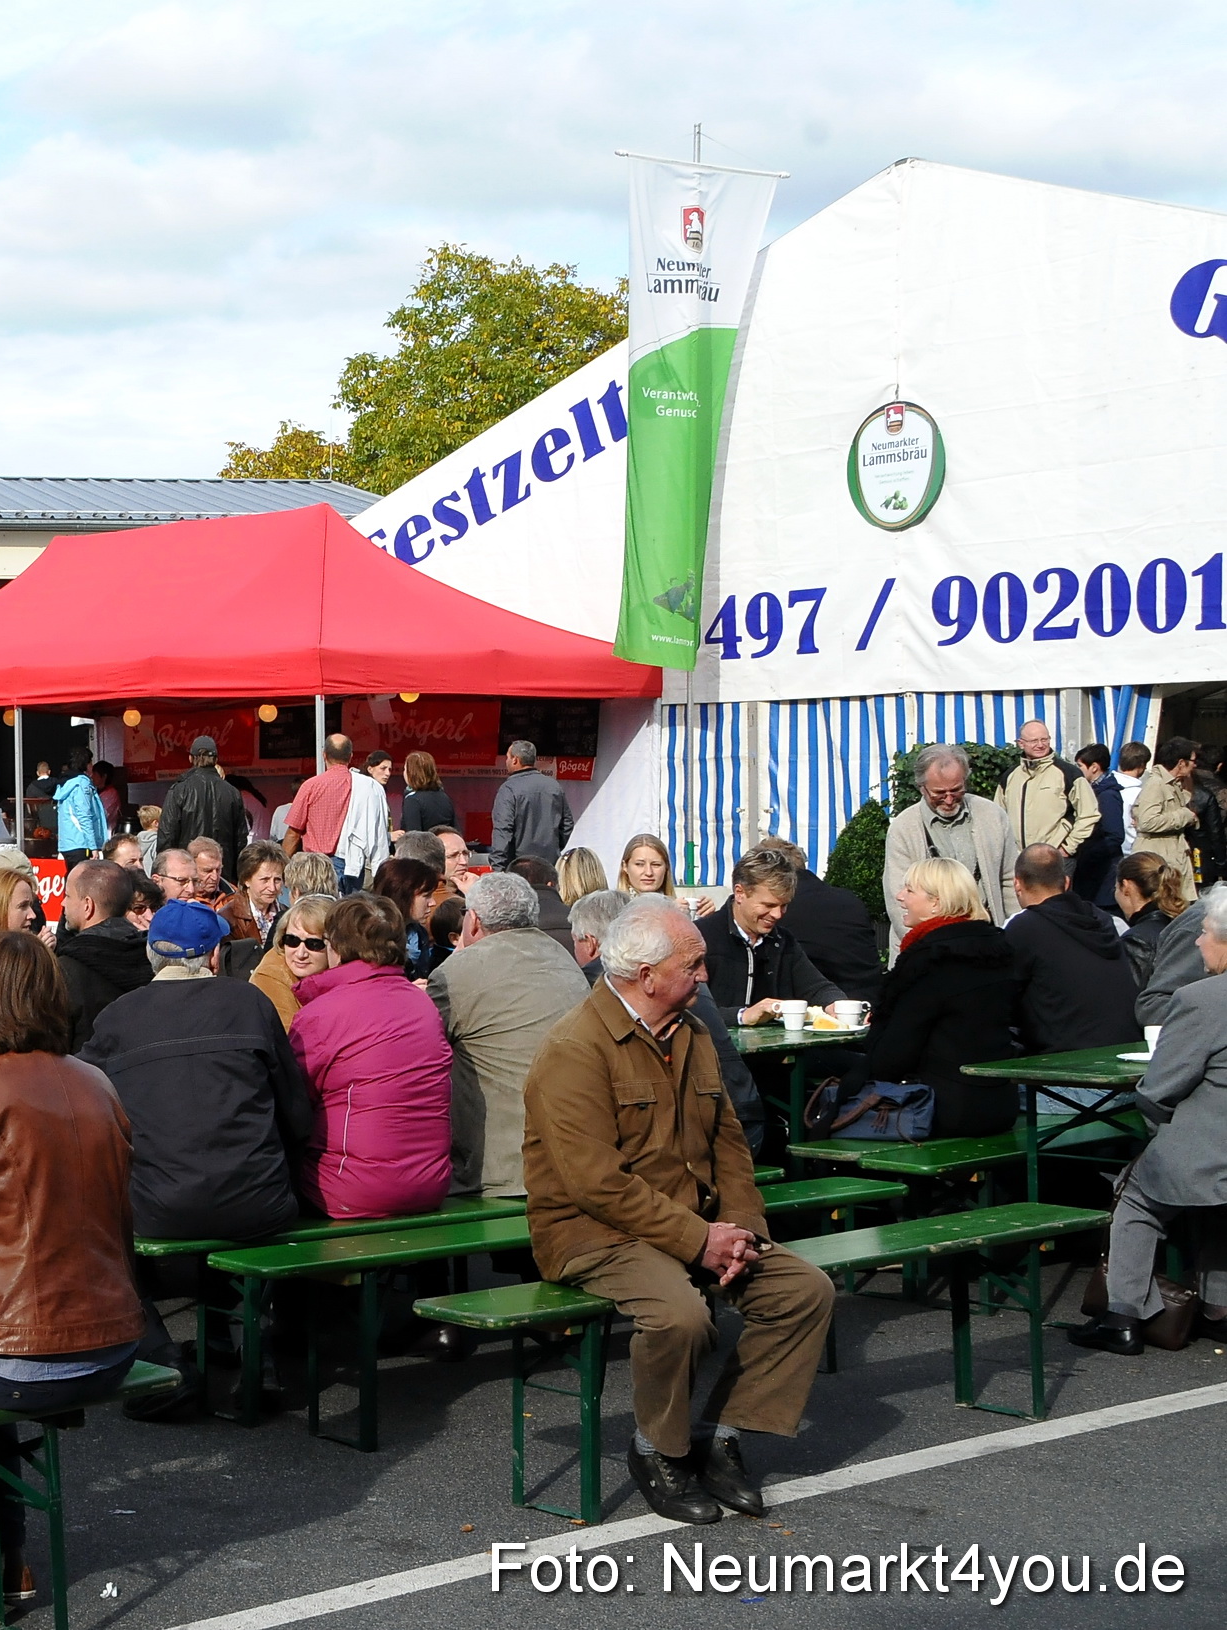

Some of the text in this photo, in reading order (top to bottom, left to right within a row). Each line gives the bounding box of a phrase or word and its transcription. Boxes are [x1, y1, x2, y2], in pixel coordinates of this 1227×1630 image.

[871, 437, 919, 452] Neumarkter
[862, 446, 928, 467] Lammsbräu
[559, 760, 591, 774] Bögerl
